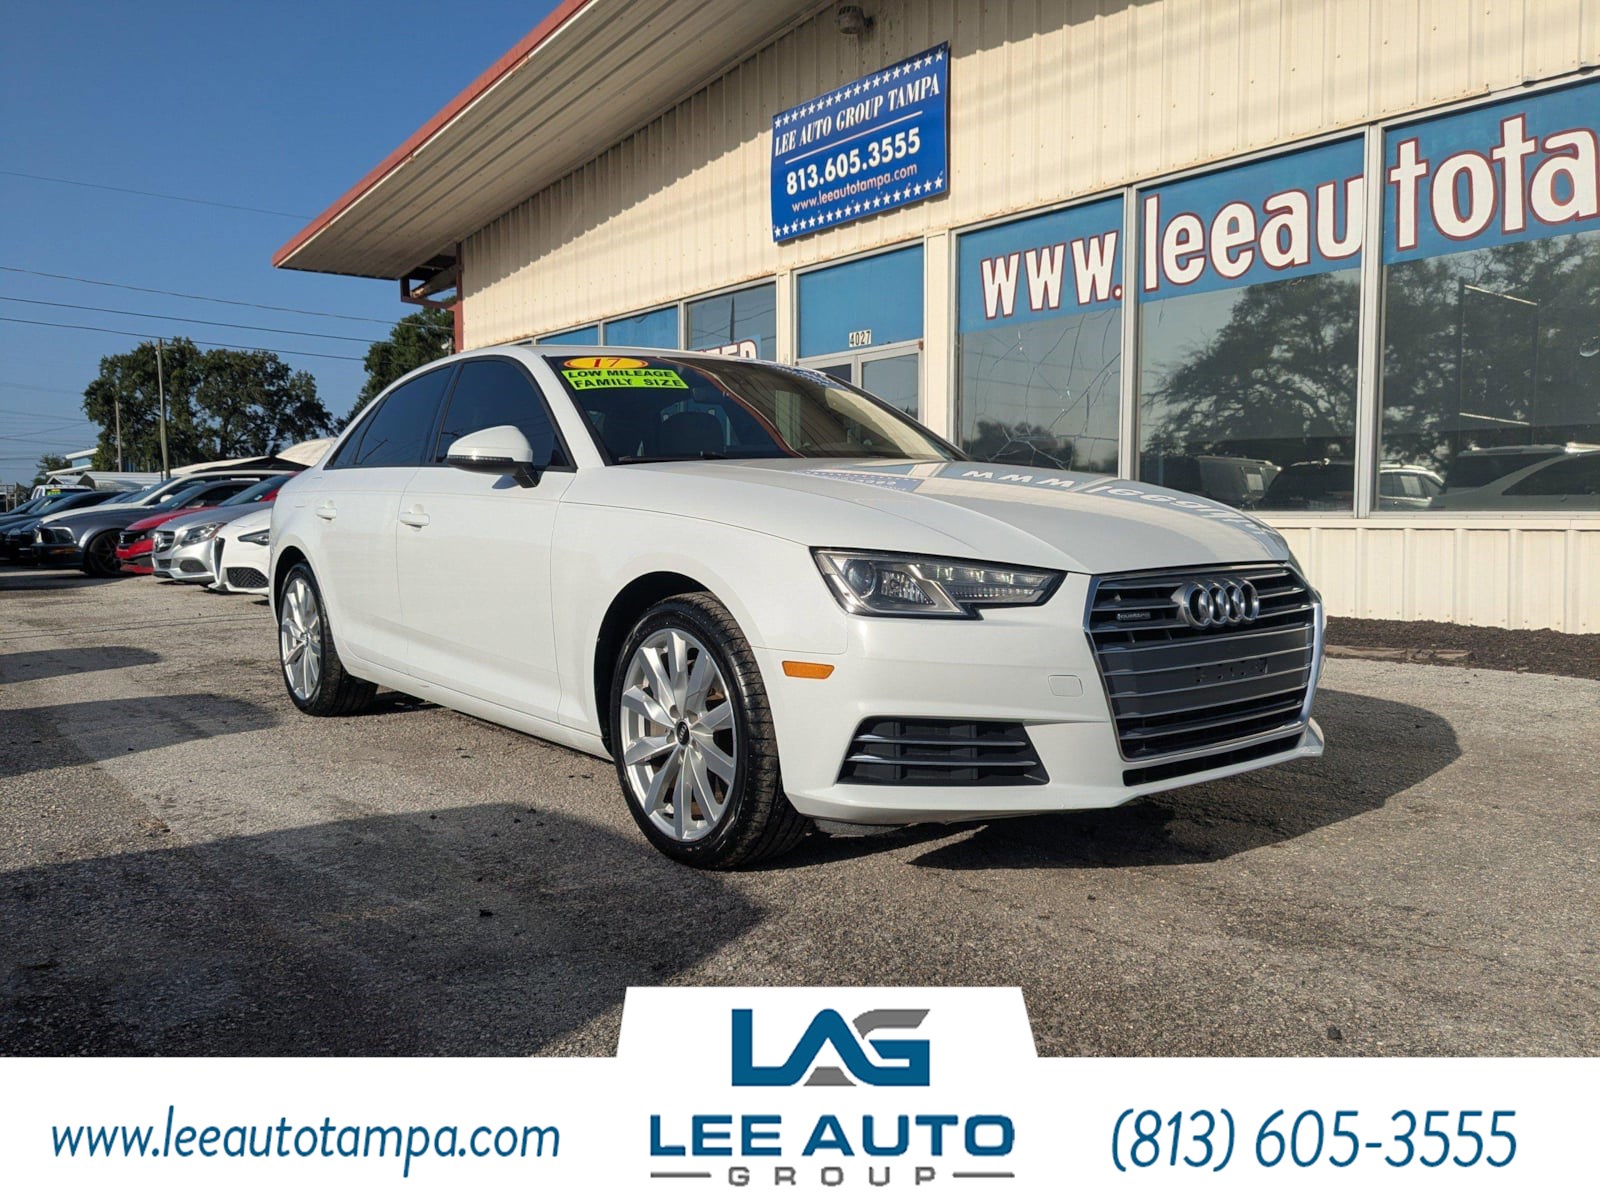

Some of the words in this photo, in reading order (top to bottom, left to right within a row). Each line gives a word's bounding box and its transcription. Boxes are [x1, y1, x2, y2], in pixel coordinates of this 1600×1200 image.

[775, 129, 797, 157] LEE
[799, 118, 832, 147] AUTO
[836, 97, 884, 131] GROUP
[887, 73, 940, 112] TAMPA
[786, 127, 921, 195] 813.605.3555
[791, 164, 918, 213] www.leeautotampa.com
[849, 331, 871, 346] 4027
[592, 358, 621, 368] 17
[568, 370, 603, 379] LOW
[606, 369, 674, 378] MILEAGE
[573, 378, 633, 388] FAMILY
[644, 378, 682, 387] SIZE
